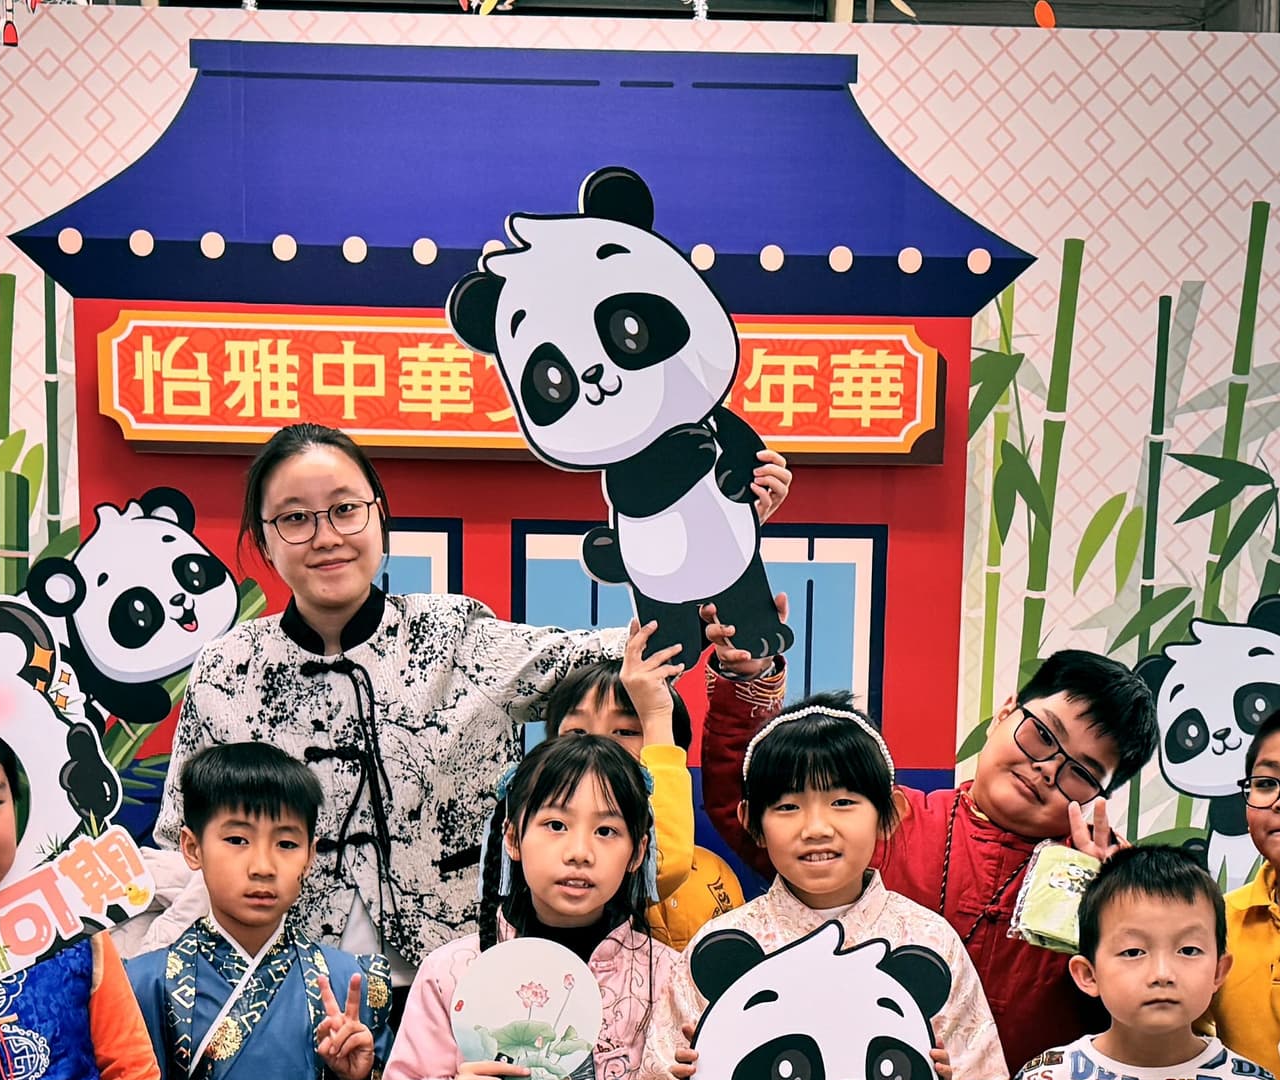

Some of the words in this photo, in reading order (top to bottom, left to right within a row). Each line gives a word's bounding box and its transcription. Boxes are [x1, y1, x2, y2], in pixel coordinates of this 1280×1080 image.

[133, 335, 905, 428] 怡雅中華年華
